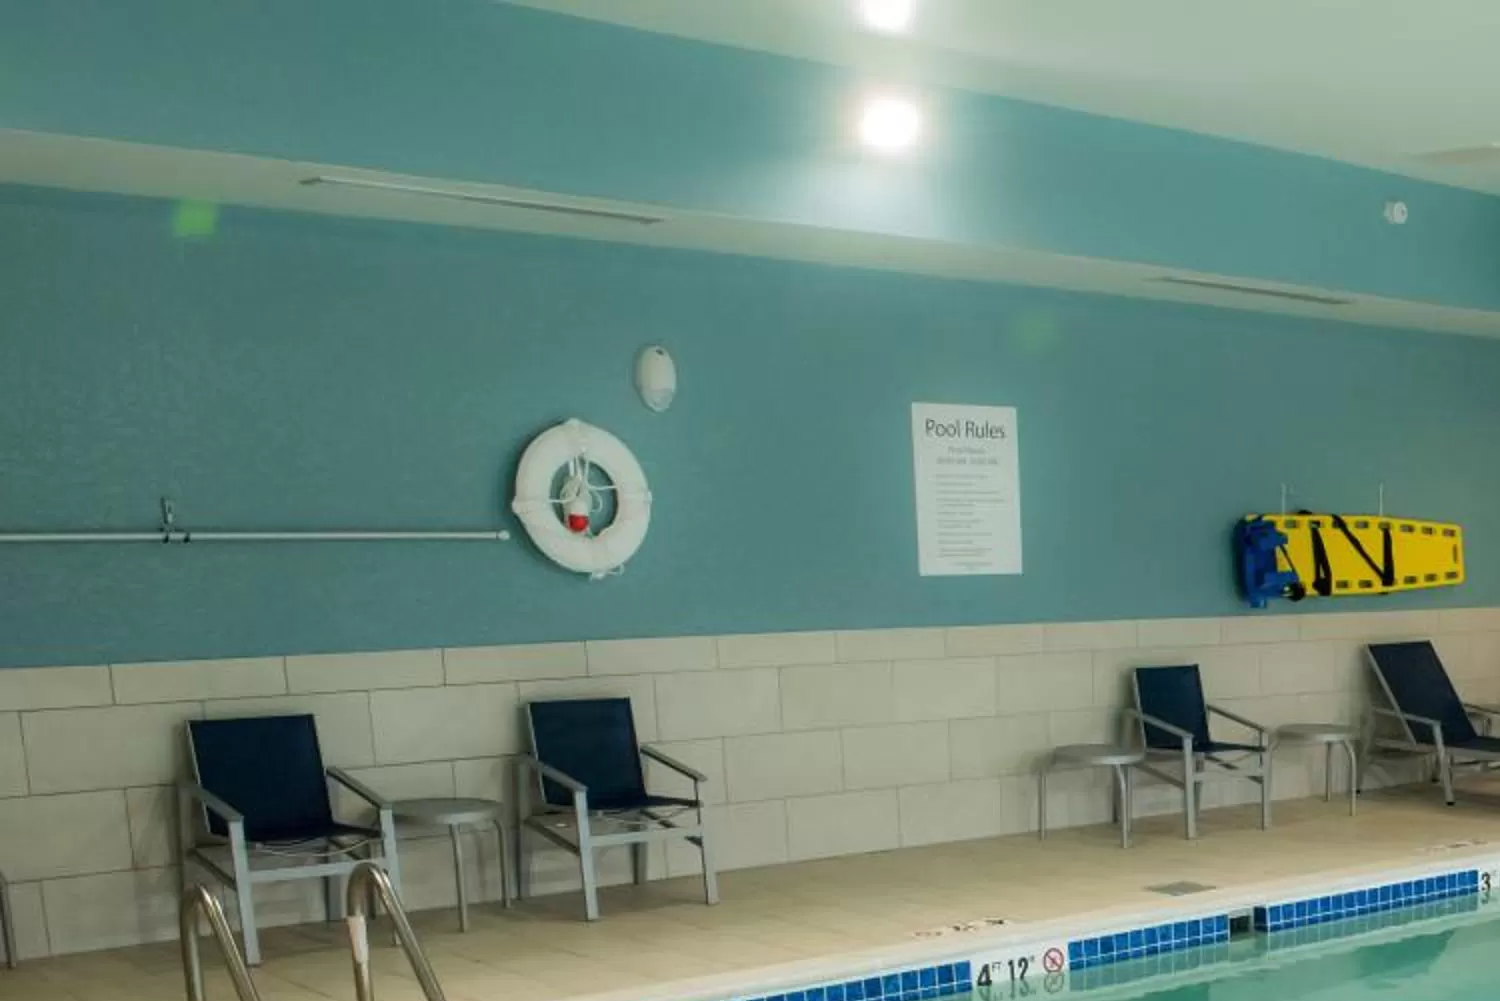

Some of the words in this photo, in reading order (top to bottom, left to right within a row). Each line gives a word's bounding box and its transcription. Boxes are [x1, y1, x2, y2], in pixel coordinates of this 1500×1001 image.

[925, 418, 961, 439] Pool
[965, 420, 1005, 440] Rules
[977, 963, 992, 987] 4
